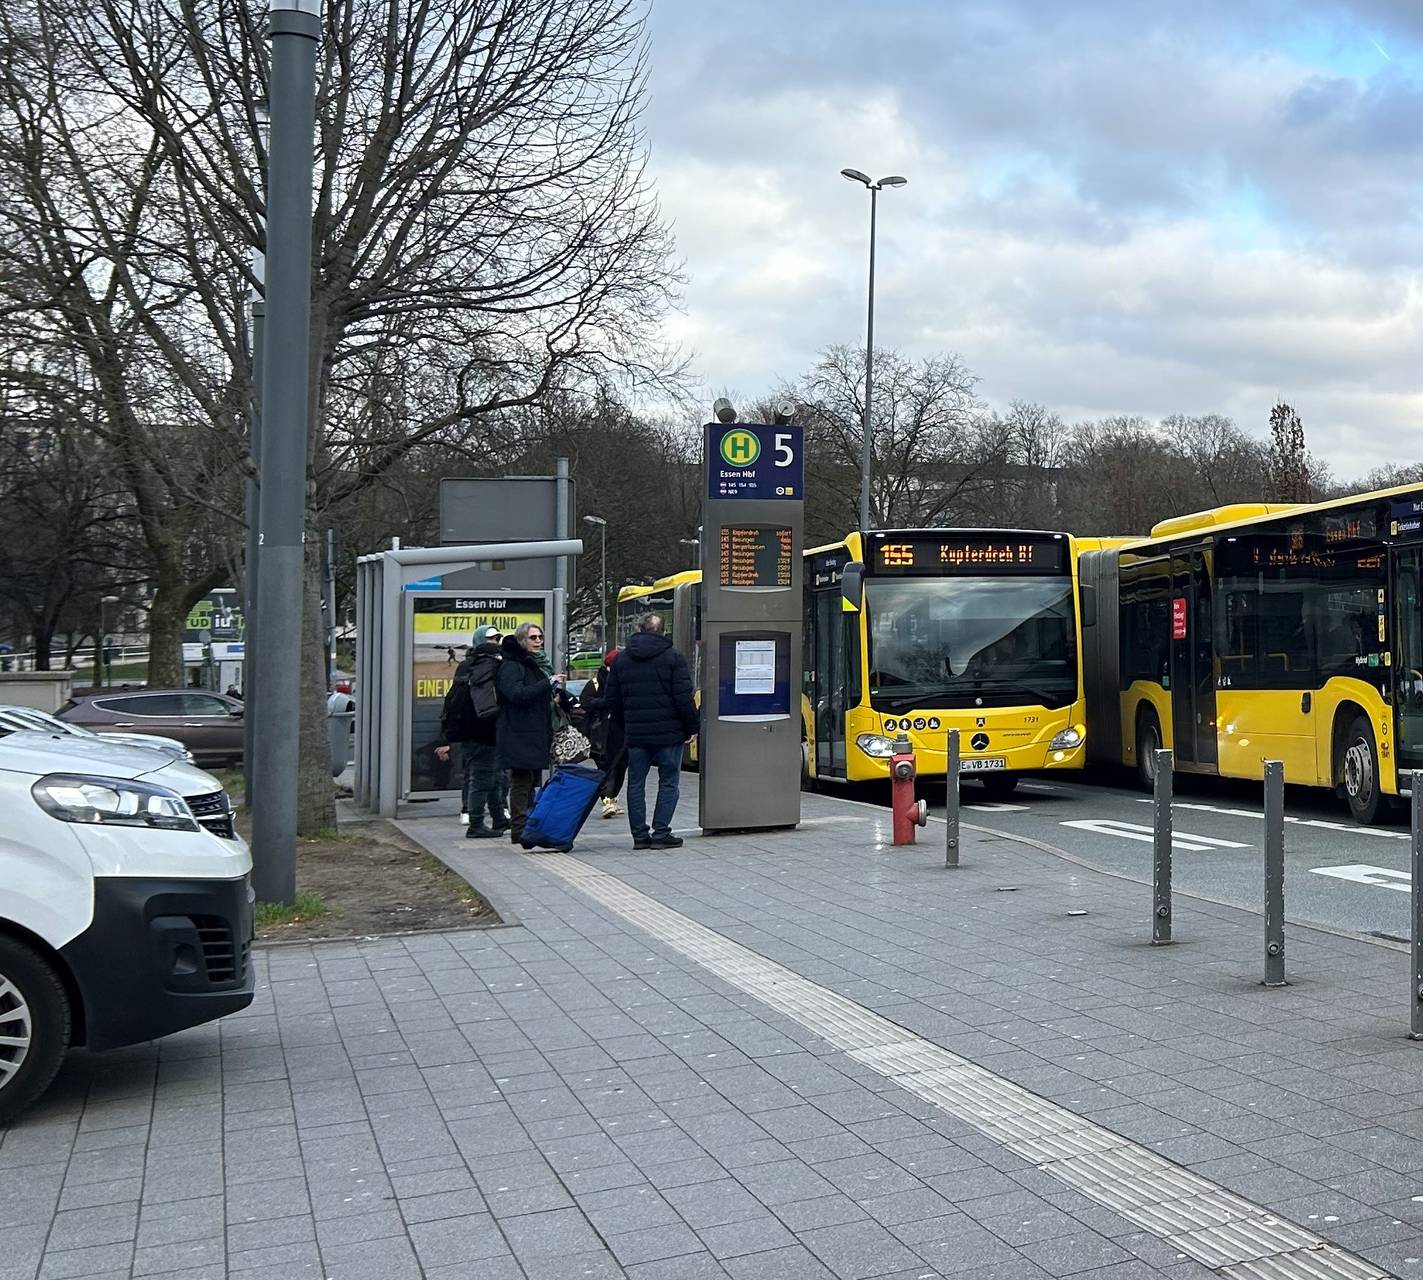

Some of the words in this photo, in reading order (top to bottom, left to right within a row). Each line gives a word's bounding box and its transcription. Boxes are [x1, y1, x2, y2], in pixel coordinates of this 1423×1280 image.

[731, 437, 750, 459] H
[775, 433, 794, 467] 5
[720, 470, 741, 478] Essen
[742, 470, 756, 478] Hbf
[880, 545, 914, 566] 155
[940, 545, 1014, 565] Kupferdreh
[455, 599, 486, 609] Essen
[488, 599, 506, 609] Hbf
[441, 616, 471, 631] JETZT
[475, 616, 488, 630] IM
[491, 616, 518, 631] KINO
[961, 761, 967, 770] E
[972, 760, 983, 769] VB
[984, 760, 1004, 768] 1731
